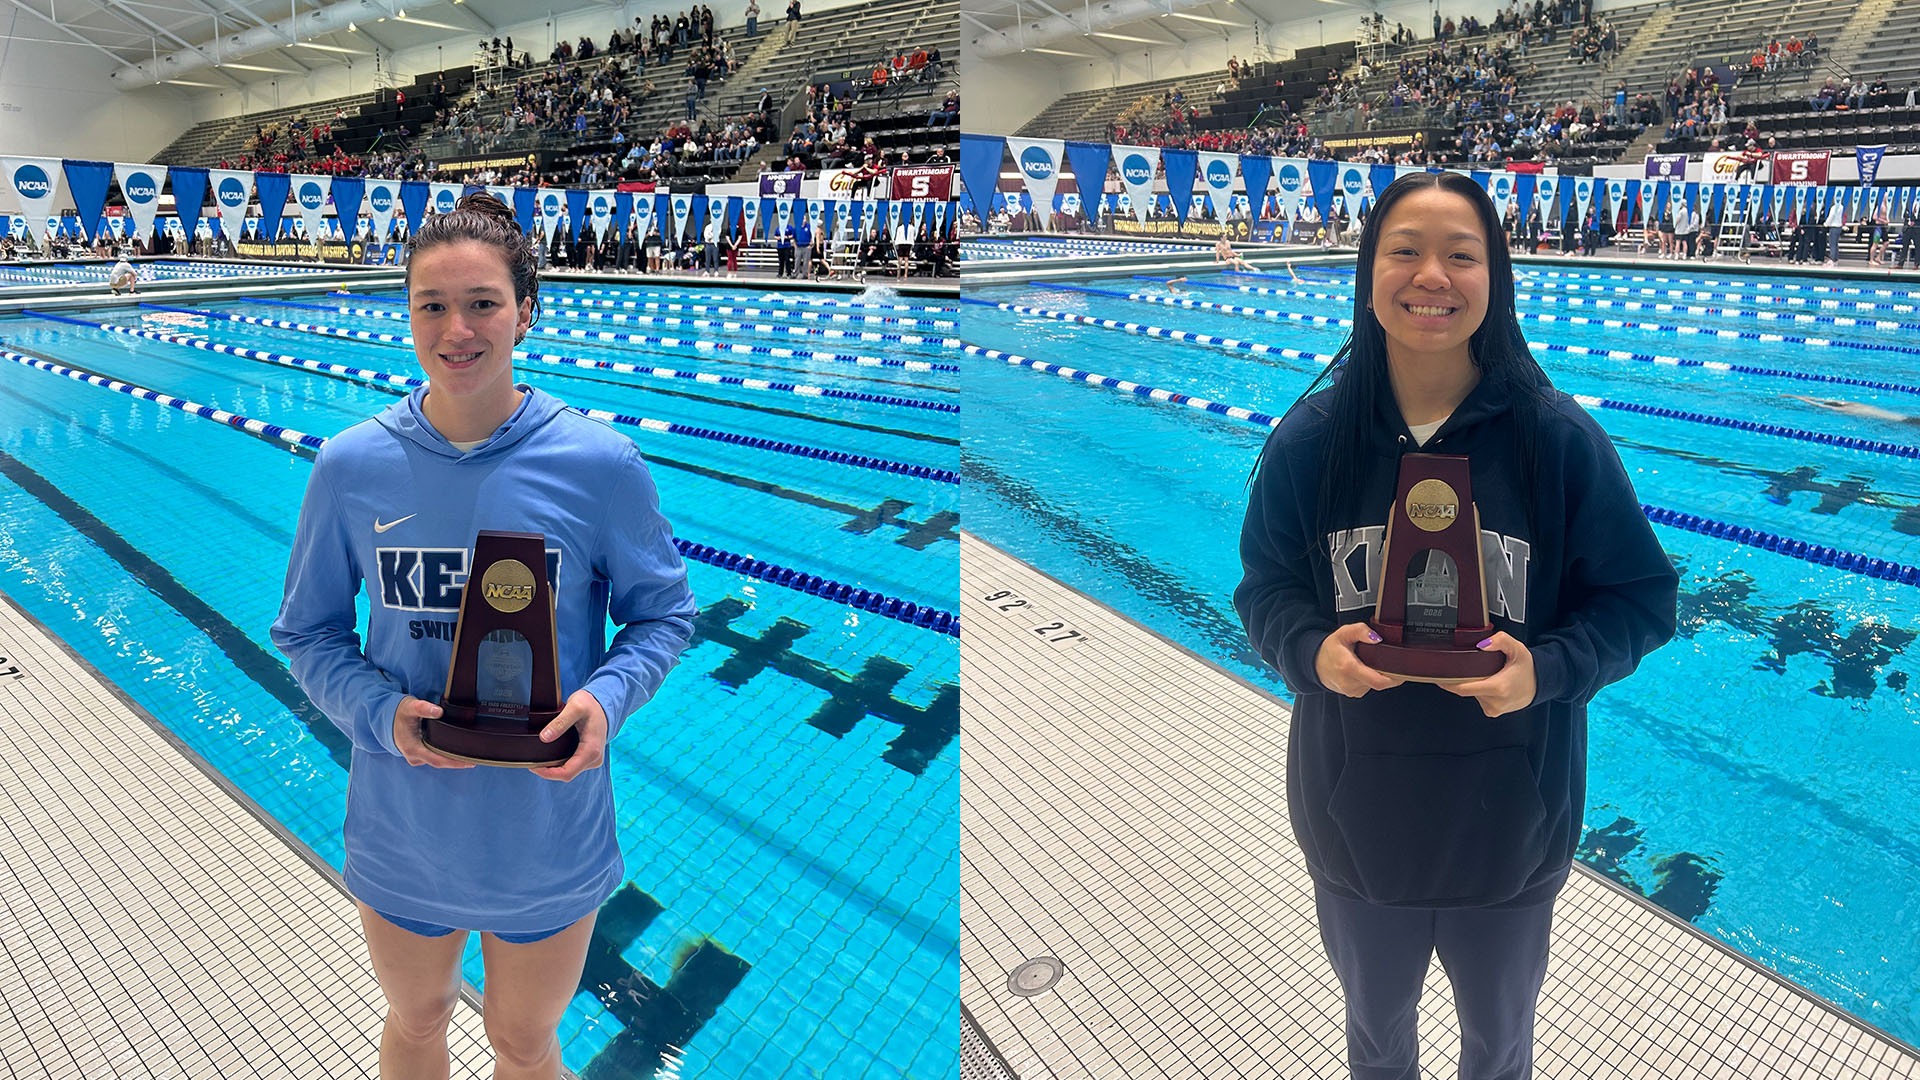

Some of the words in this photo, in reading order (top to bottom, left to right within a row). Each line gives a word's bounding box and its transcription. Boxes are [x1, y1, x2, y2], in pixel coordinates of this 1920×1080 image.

[1776, 152, 1827, 160] SWARTHMORE
[896, 168, 950, 176] SWARTHMORE
[1024, 162, 1053, 172] NCAA
[1790, 160, 1809, 180] S
[1125, 168, 1150, 178] NCAA
[1208, 173, 1231, 182] NCAA
[18, 180, 48, 191] NCAA
[1281, 177, 1300, 185] NCAA
[1345, 180, 1362, 188] NCAA
[128, 186, 156, 196] NCAA
[911, 176, 930, 197] S
[221, 191, 244, 200] NCAA
[301, 194, 322, 204] NCAA
[372, 198, 392, 207] NCAA
[545, 204, 560, 212] NCAA
[1408, 502, 1457, 519] NCAA
[486, 583, 534, 601] NCAA
